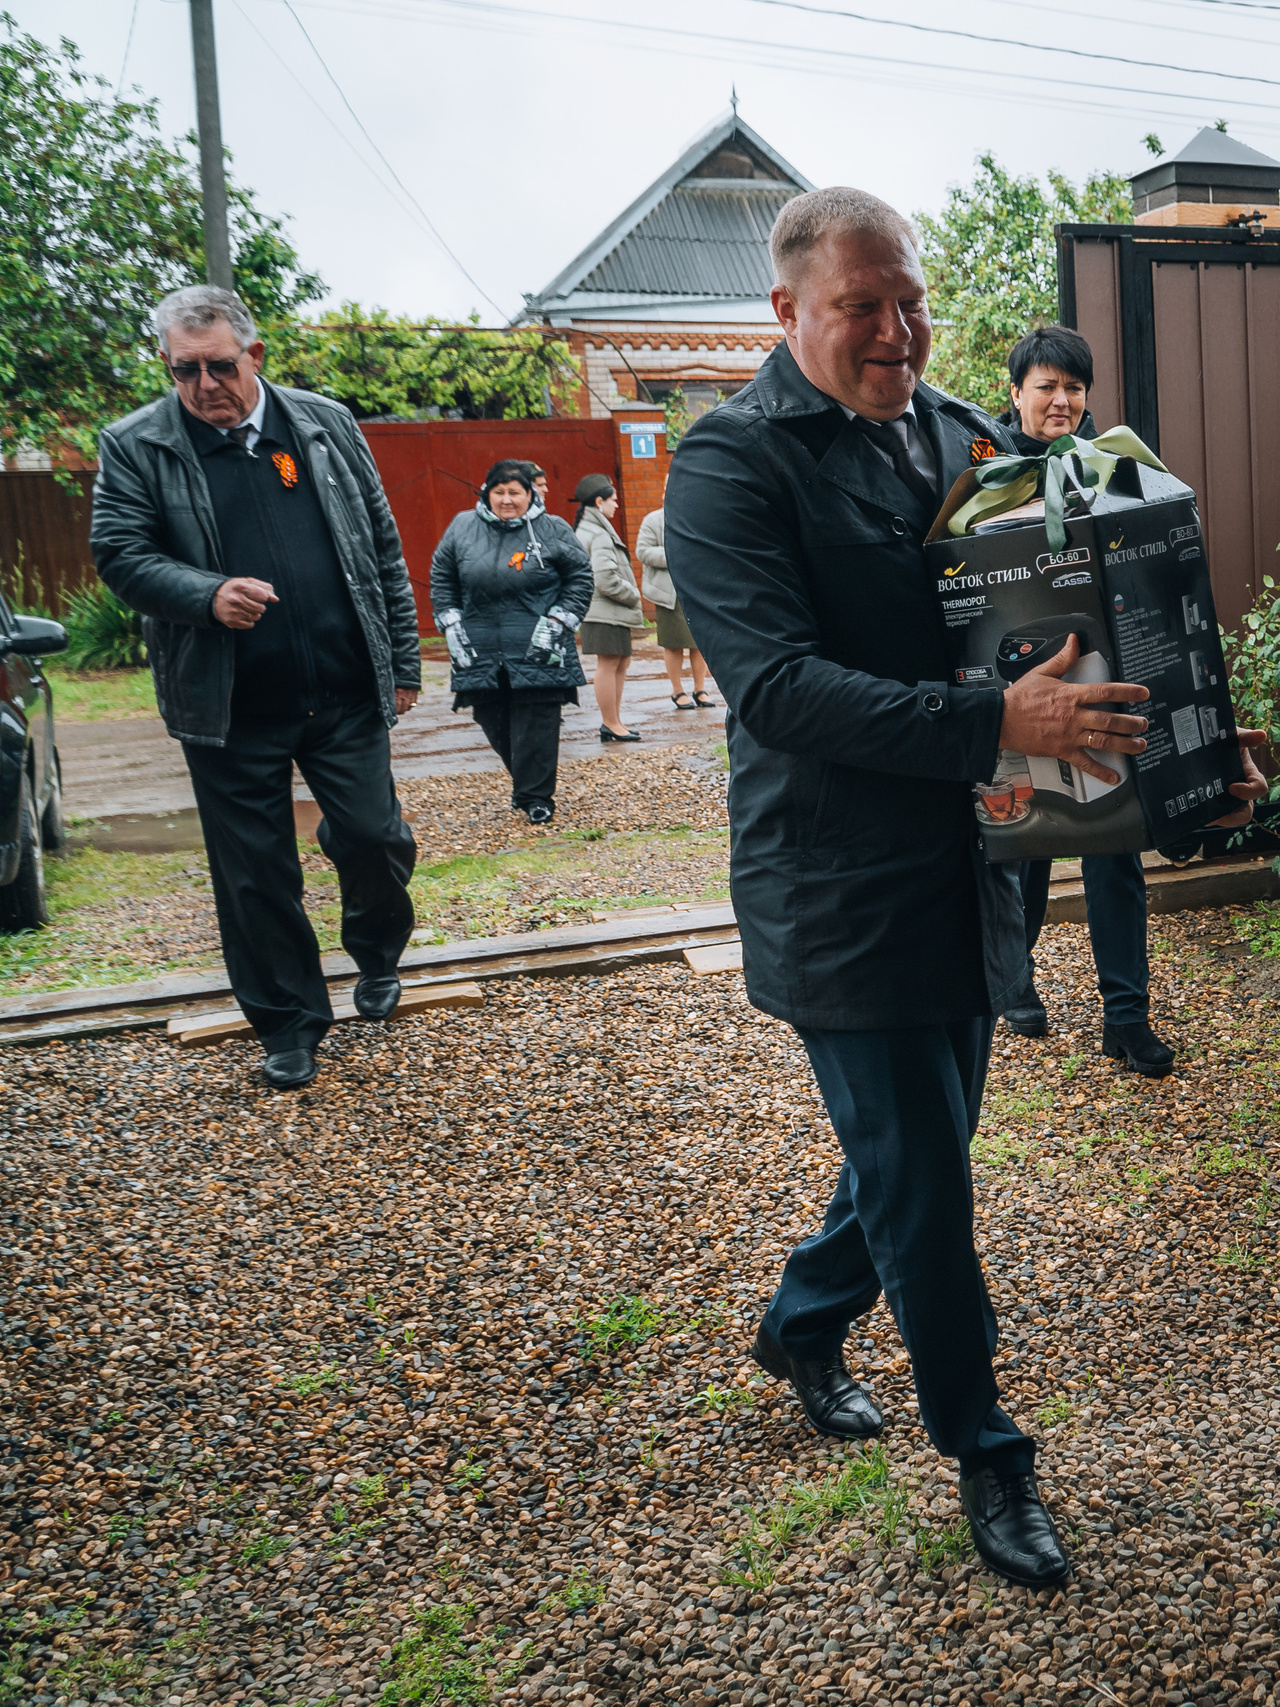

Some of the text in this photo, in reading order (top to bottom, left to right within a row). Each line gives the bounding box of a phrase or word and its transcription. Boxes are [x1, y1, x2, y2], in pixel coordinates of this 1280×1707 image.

[1104, 541, 1168, 567] ВОСТОК СТИЛЬ
[1178, 550, 1200, 562] CLASSIC
[937, 566, 1032, 593] ВОСТОК СТИЛЬ
[1051, 576, 1092, 589] CLASSIC
[941, 595, 986, 610] THERMOPOT
[958, 670, 965, 681] 3
